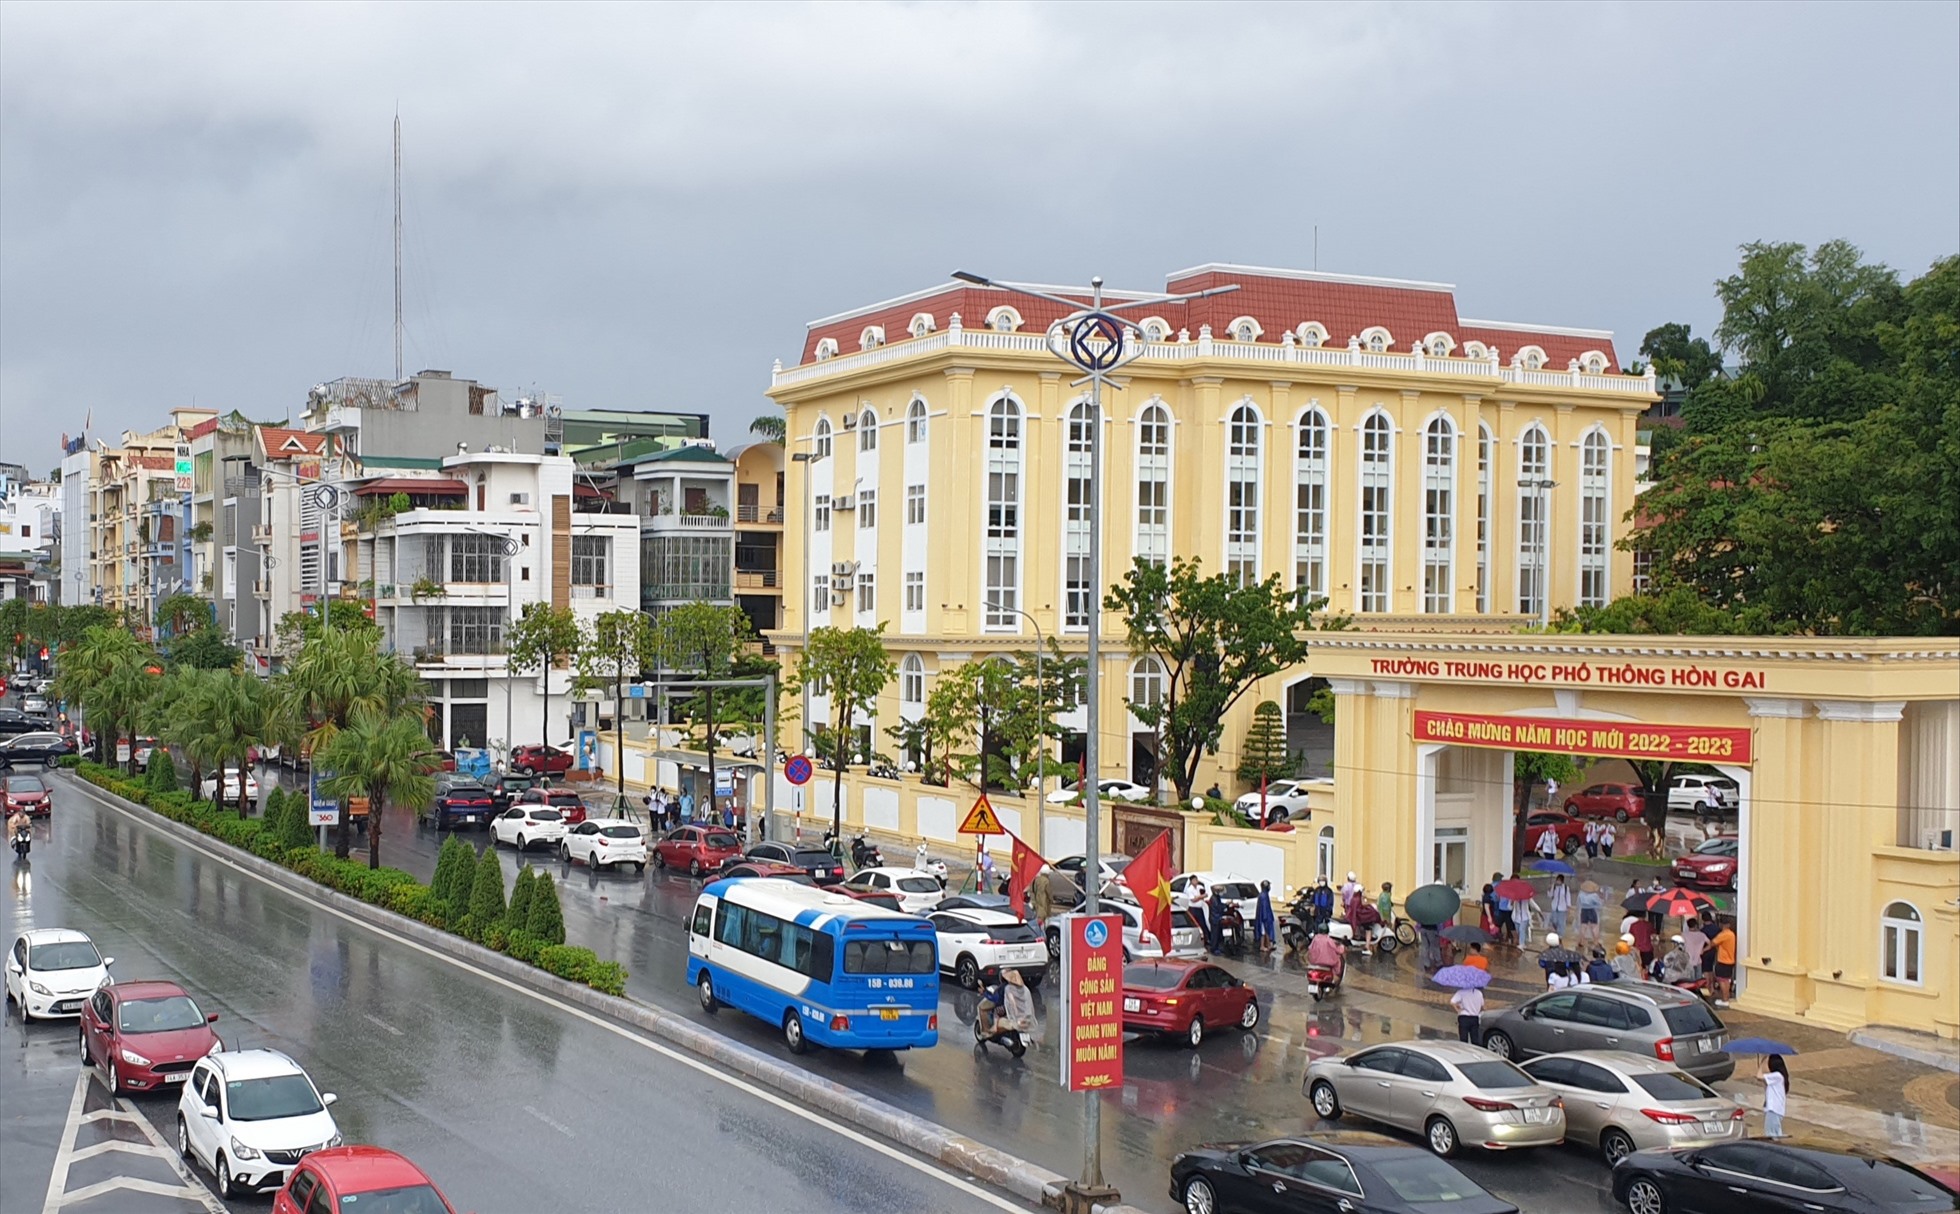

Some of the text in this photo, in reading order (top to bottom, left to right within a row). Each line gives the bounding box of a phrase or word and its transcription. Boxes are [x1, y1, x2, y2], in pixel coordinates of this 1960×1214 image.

[1371, 656, 1440, 676] TRƯỜNG
[1444, 661, 1503, 679] TRUNG
[1507, 664, 1547, 683] HỌC
[1596, 663, 1666, 686] THÔNG
[1671, 665, 1717, 687] HÒN
[1723, 670, 1765, 689] GAI
[1426, 718, 1464, 738] CHÀO
[1467, 720, 1511, 743] MỪNG
[1515, 723, 1551, 745] NĂM
[1555, 728, 1587, 750] HỌC
[1592, 728, 1624, 750] MỚI
[1628, 733, 1671, 753] 2022
[1687, 736, 1733, 756] 2023
[1087, 951, 1107, 972] ĐẢNG
[1079, 973, 1115, 998] CỘNG SẢN
[1080, 1000, 1096, 1020] VIỆT
[1096, 1001, 1113, 1016] NAM
[1075, 1022, 1118, 1042] QUANG VINH
[1098, 1043, 1118, 1061] NĂM!
